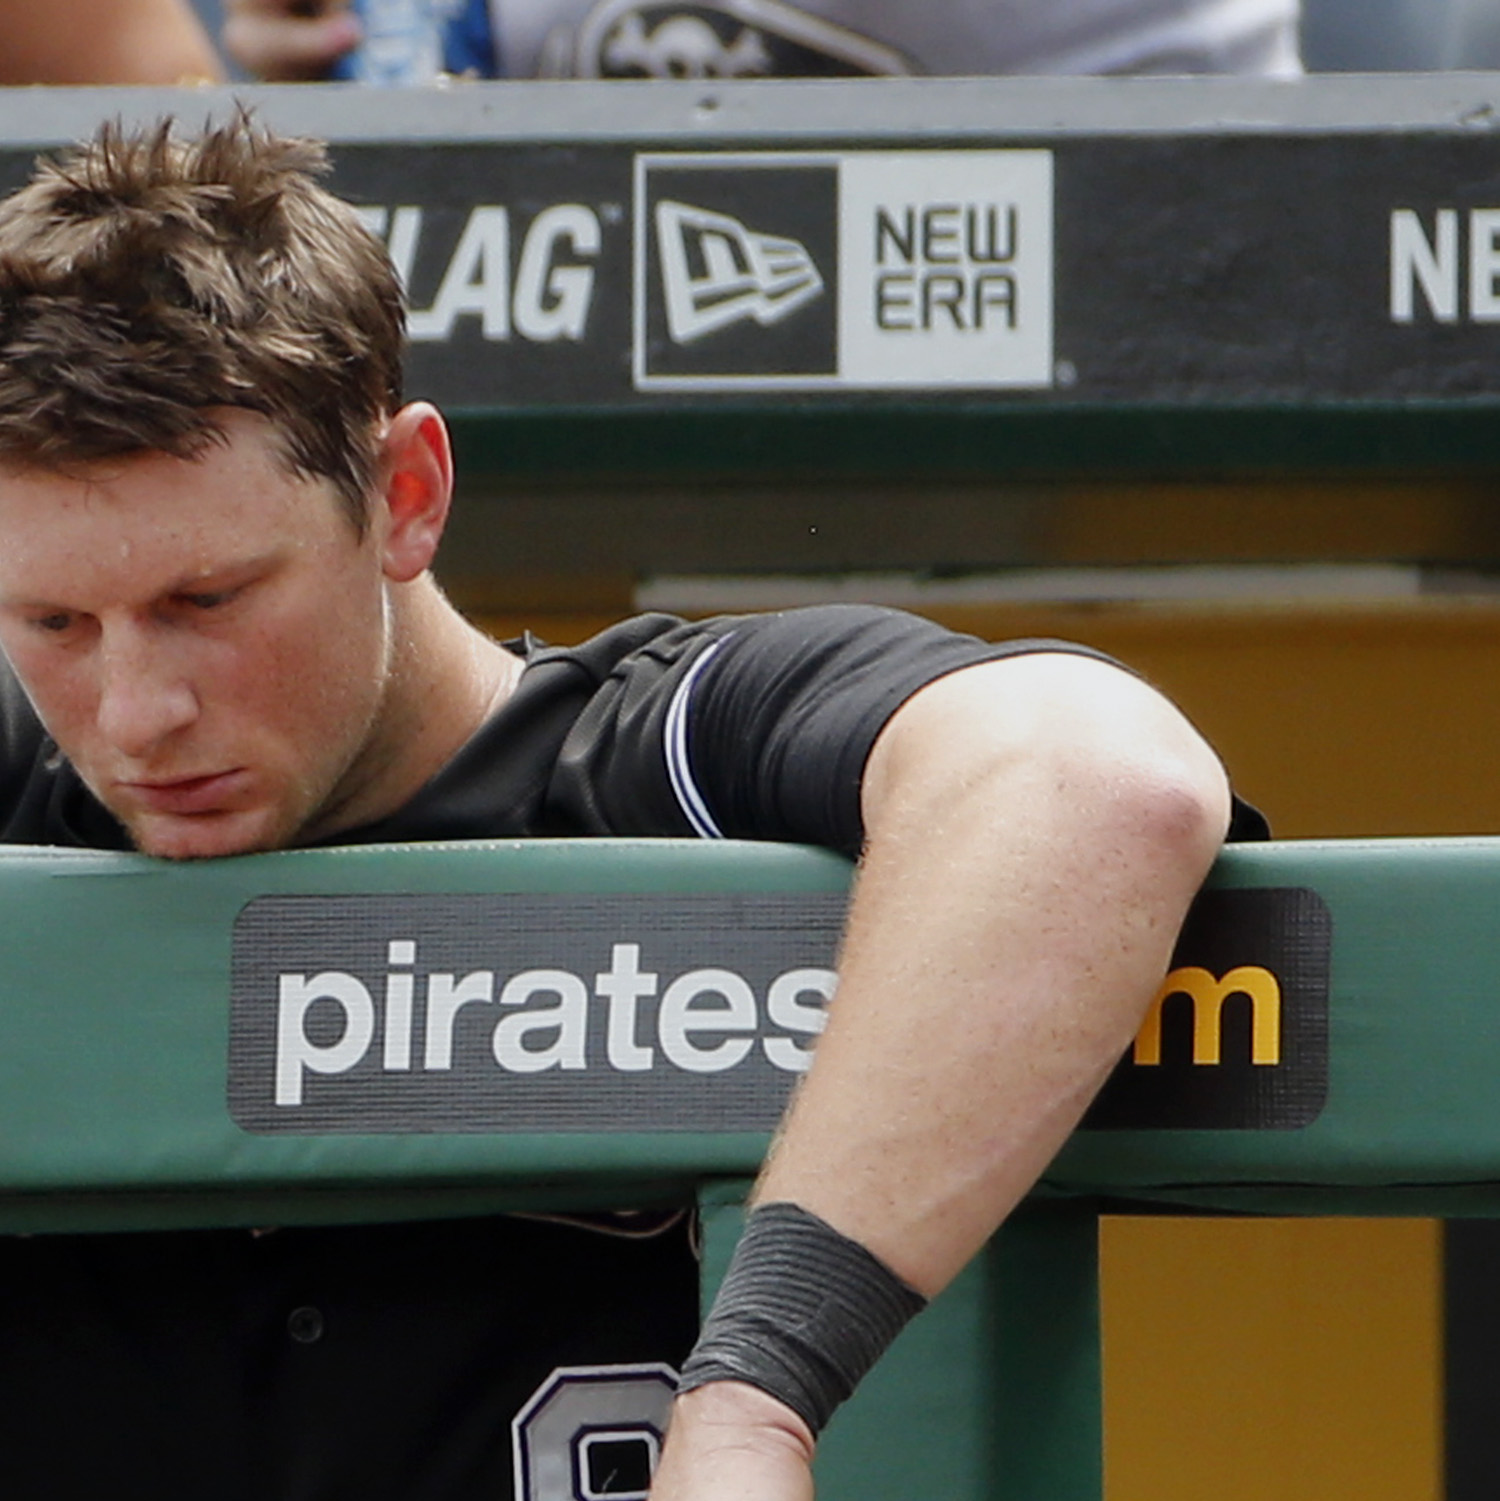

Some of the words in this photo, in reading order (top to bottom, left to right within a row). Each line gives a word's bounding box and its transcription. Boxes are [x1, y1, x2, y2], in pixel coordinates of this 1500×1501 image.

[875, 204, 1017, 265] NEW
[342, 203, 602, 342] LAG
[875, 270, 1017, 331] ERA
